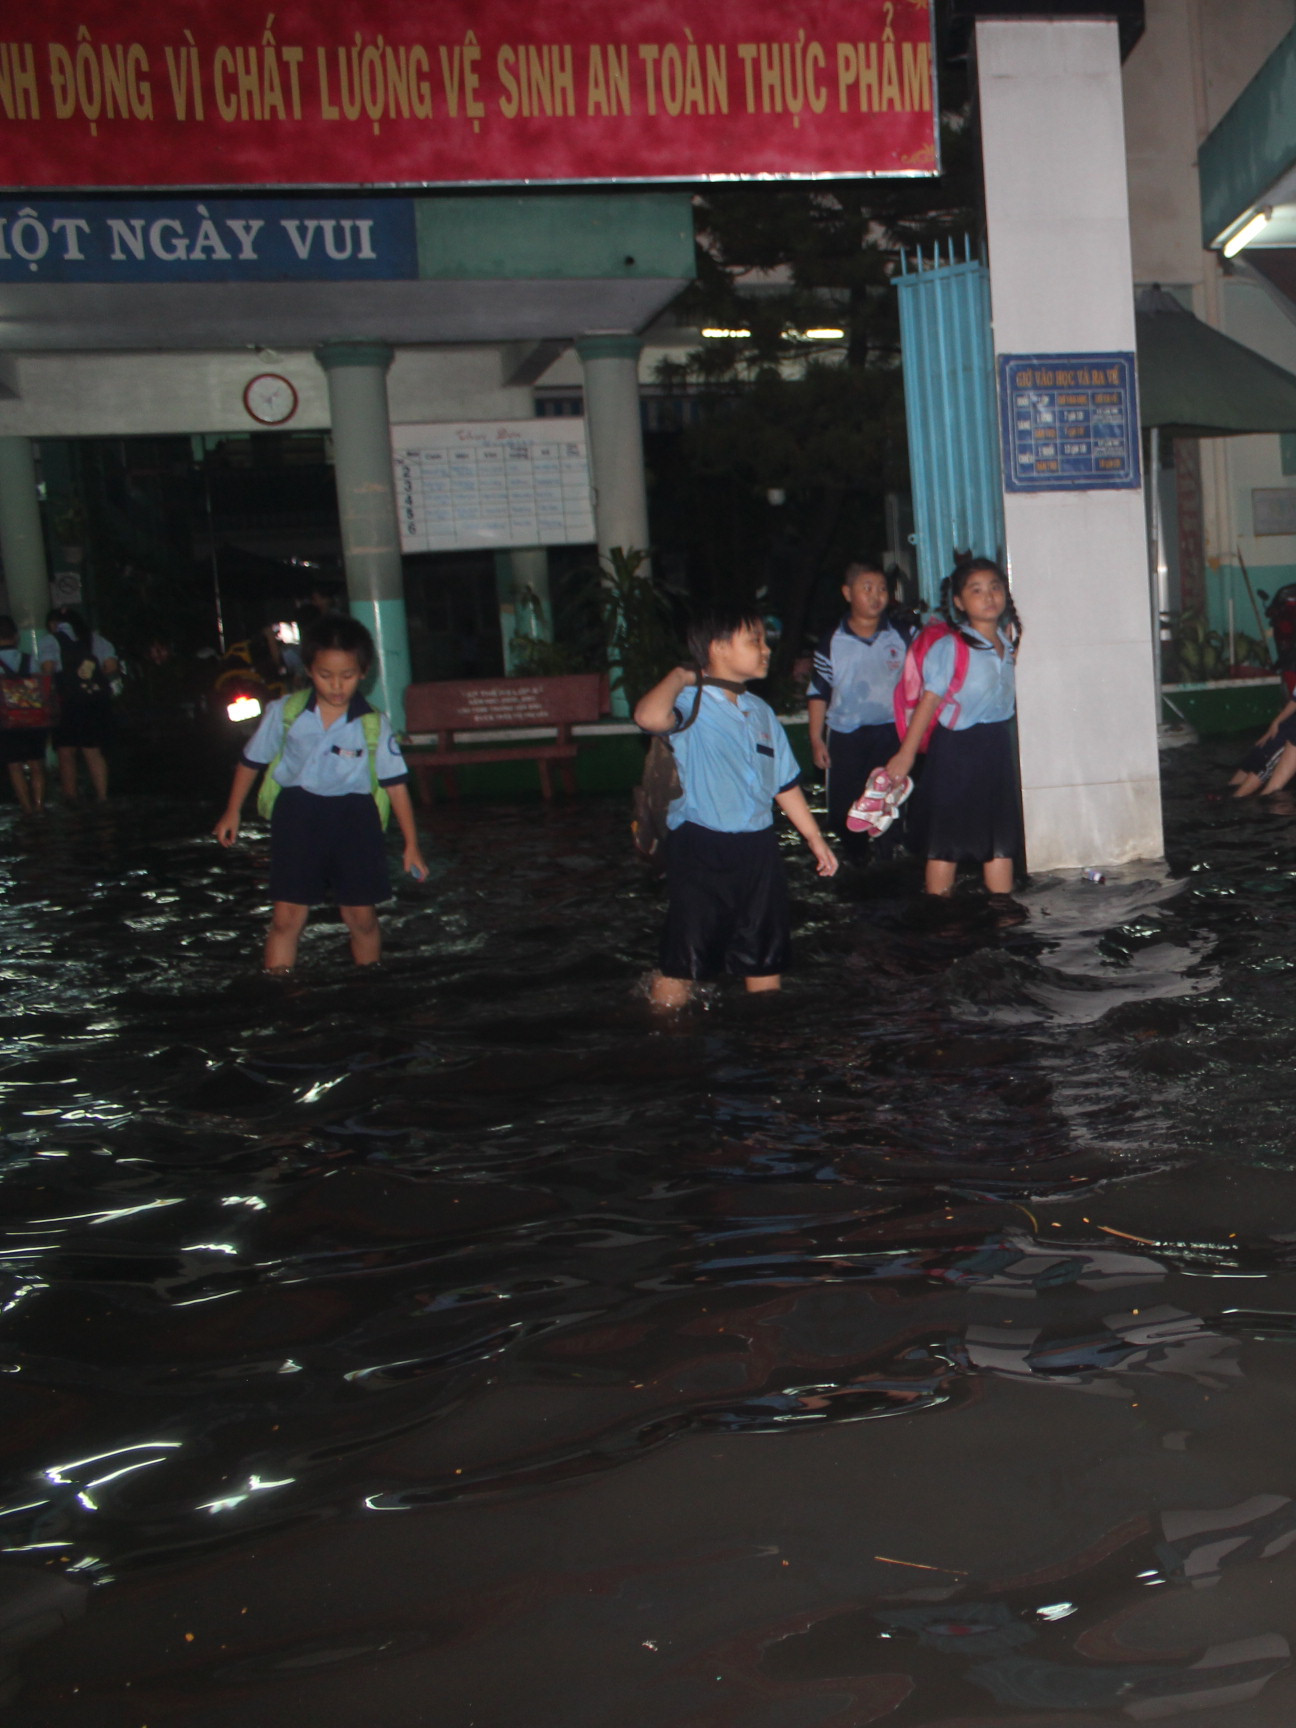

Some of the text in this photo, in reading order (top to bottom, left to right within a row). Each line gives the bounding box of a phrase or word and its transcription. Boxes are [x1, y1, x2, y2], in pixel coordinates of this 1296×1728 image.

[48, 25, 153, 137] ĐỘNG
[164, 29, 204, 121] VÌ
[213, 13, 303, 122] CHẤT
[317, 31, 433, 136] LƯỢNG
[439, 29, 485, 133] VỆ
[498, 43, 576, 119] SINH
[588, 44, 632, 117] AN
[639, 27, 729, 117] TOÀN
[738, 28, 827, 129] THỰC
[0, 204, 377, 271] ỘT NGÀY VUI
